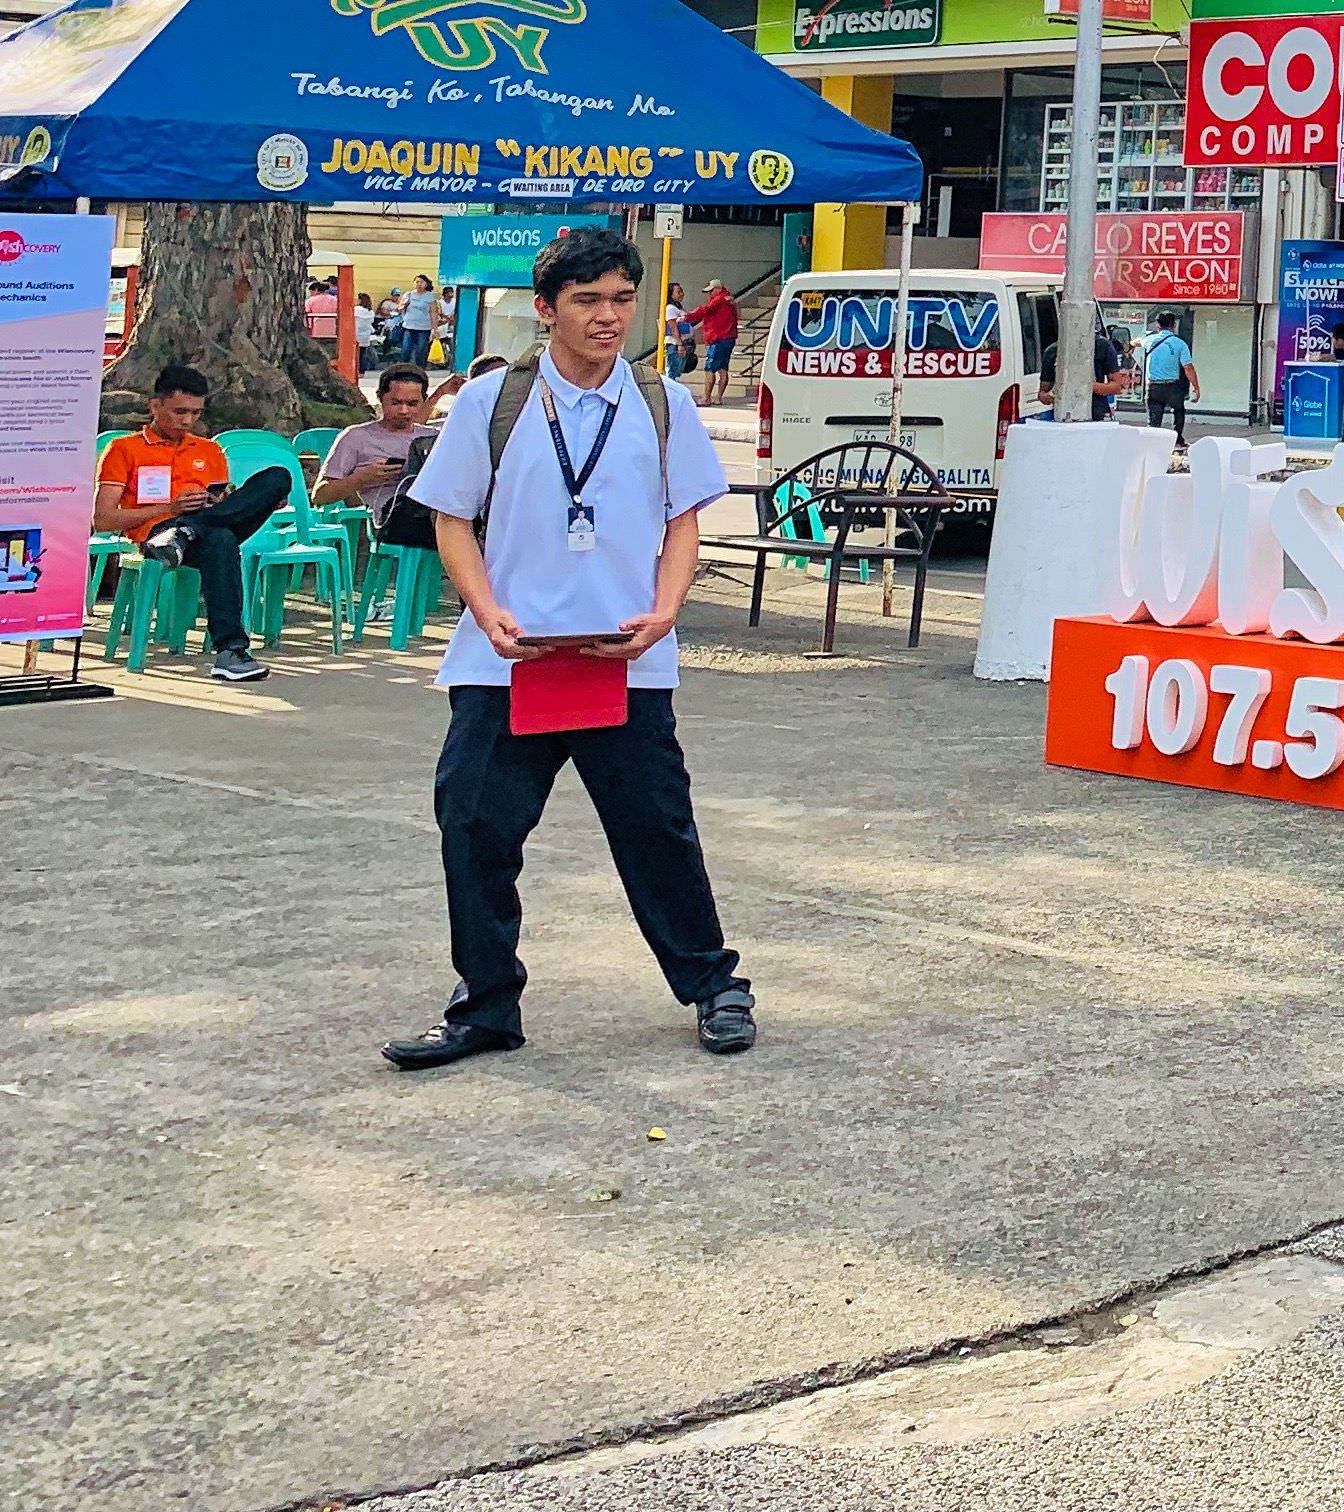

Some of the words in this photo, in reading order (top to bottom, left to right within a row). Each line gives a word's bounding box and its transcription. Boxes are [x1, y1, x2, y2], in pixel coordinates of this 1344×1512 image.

[794, 5, 934, 45] Expressions
[404, 16, 549, 76] UY
[290, 72, 413, 109] Tabangi
[488, 74, 615, 117] Tabangan
[321, 138, 481, 178] JOAQUIN
[695, 149, 740, 179] UY
[364, 175, 404, 190] VICE
[410, 176, 476, 193] MAYOR
[582, 180, 606, 193] DE
[610, 179, 645, 193] ORO
[653, 179, 696, 194] CITY
[513, 182, 549, 193] WAITING
[550, 183, 571, 193] AREA
[471, 229, 541, 247] watsons
[1028, 222, 1133, 254] CALO
[1142, 221, 1231, 254] REYES
[1093, 260, 1134, 283] AIR
[1140, 259, 1230, 284] SALON
[25, 281, 75, 291] Auditions
[1173, 283, 1200, 295] Since
[1295, 289, 1338, 301] NOW!
[784, 296, 1000, 351] UNTV
[1299, 336, 1331, 350] 50%
[786, 351, 857, 374] NEWS
[864, 352, 882, 375] &
[938, 468, 992, 486] BALITA
